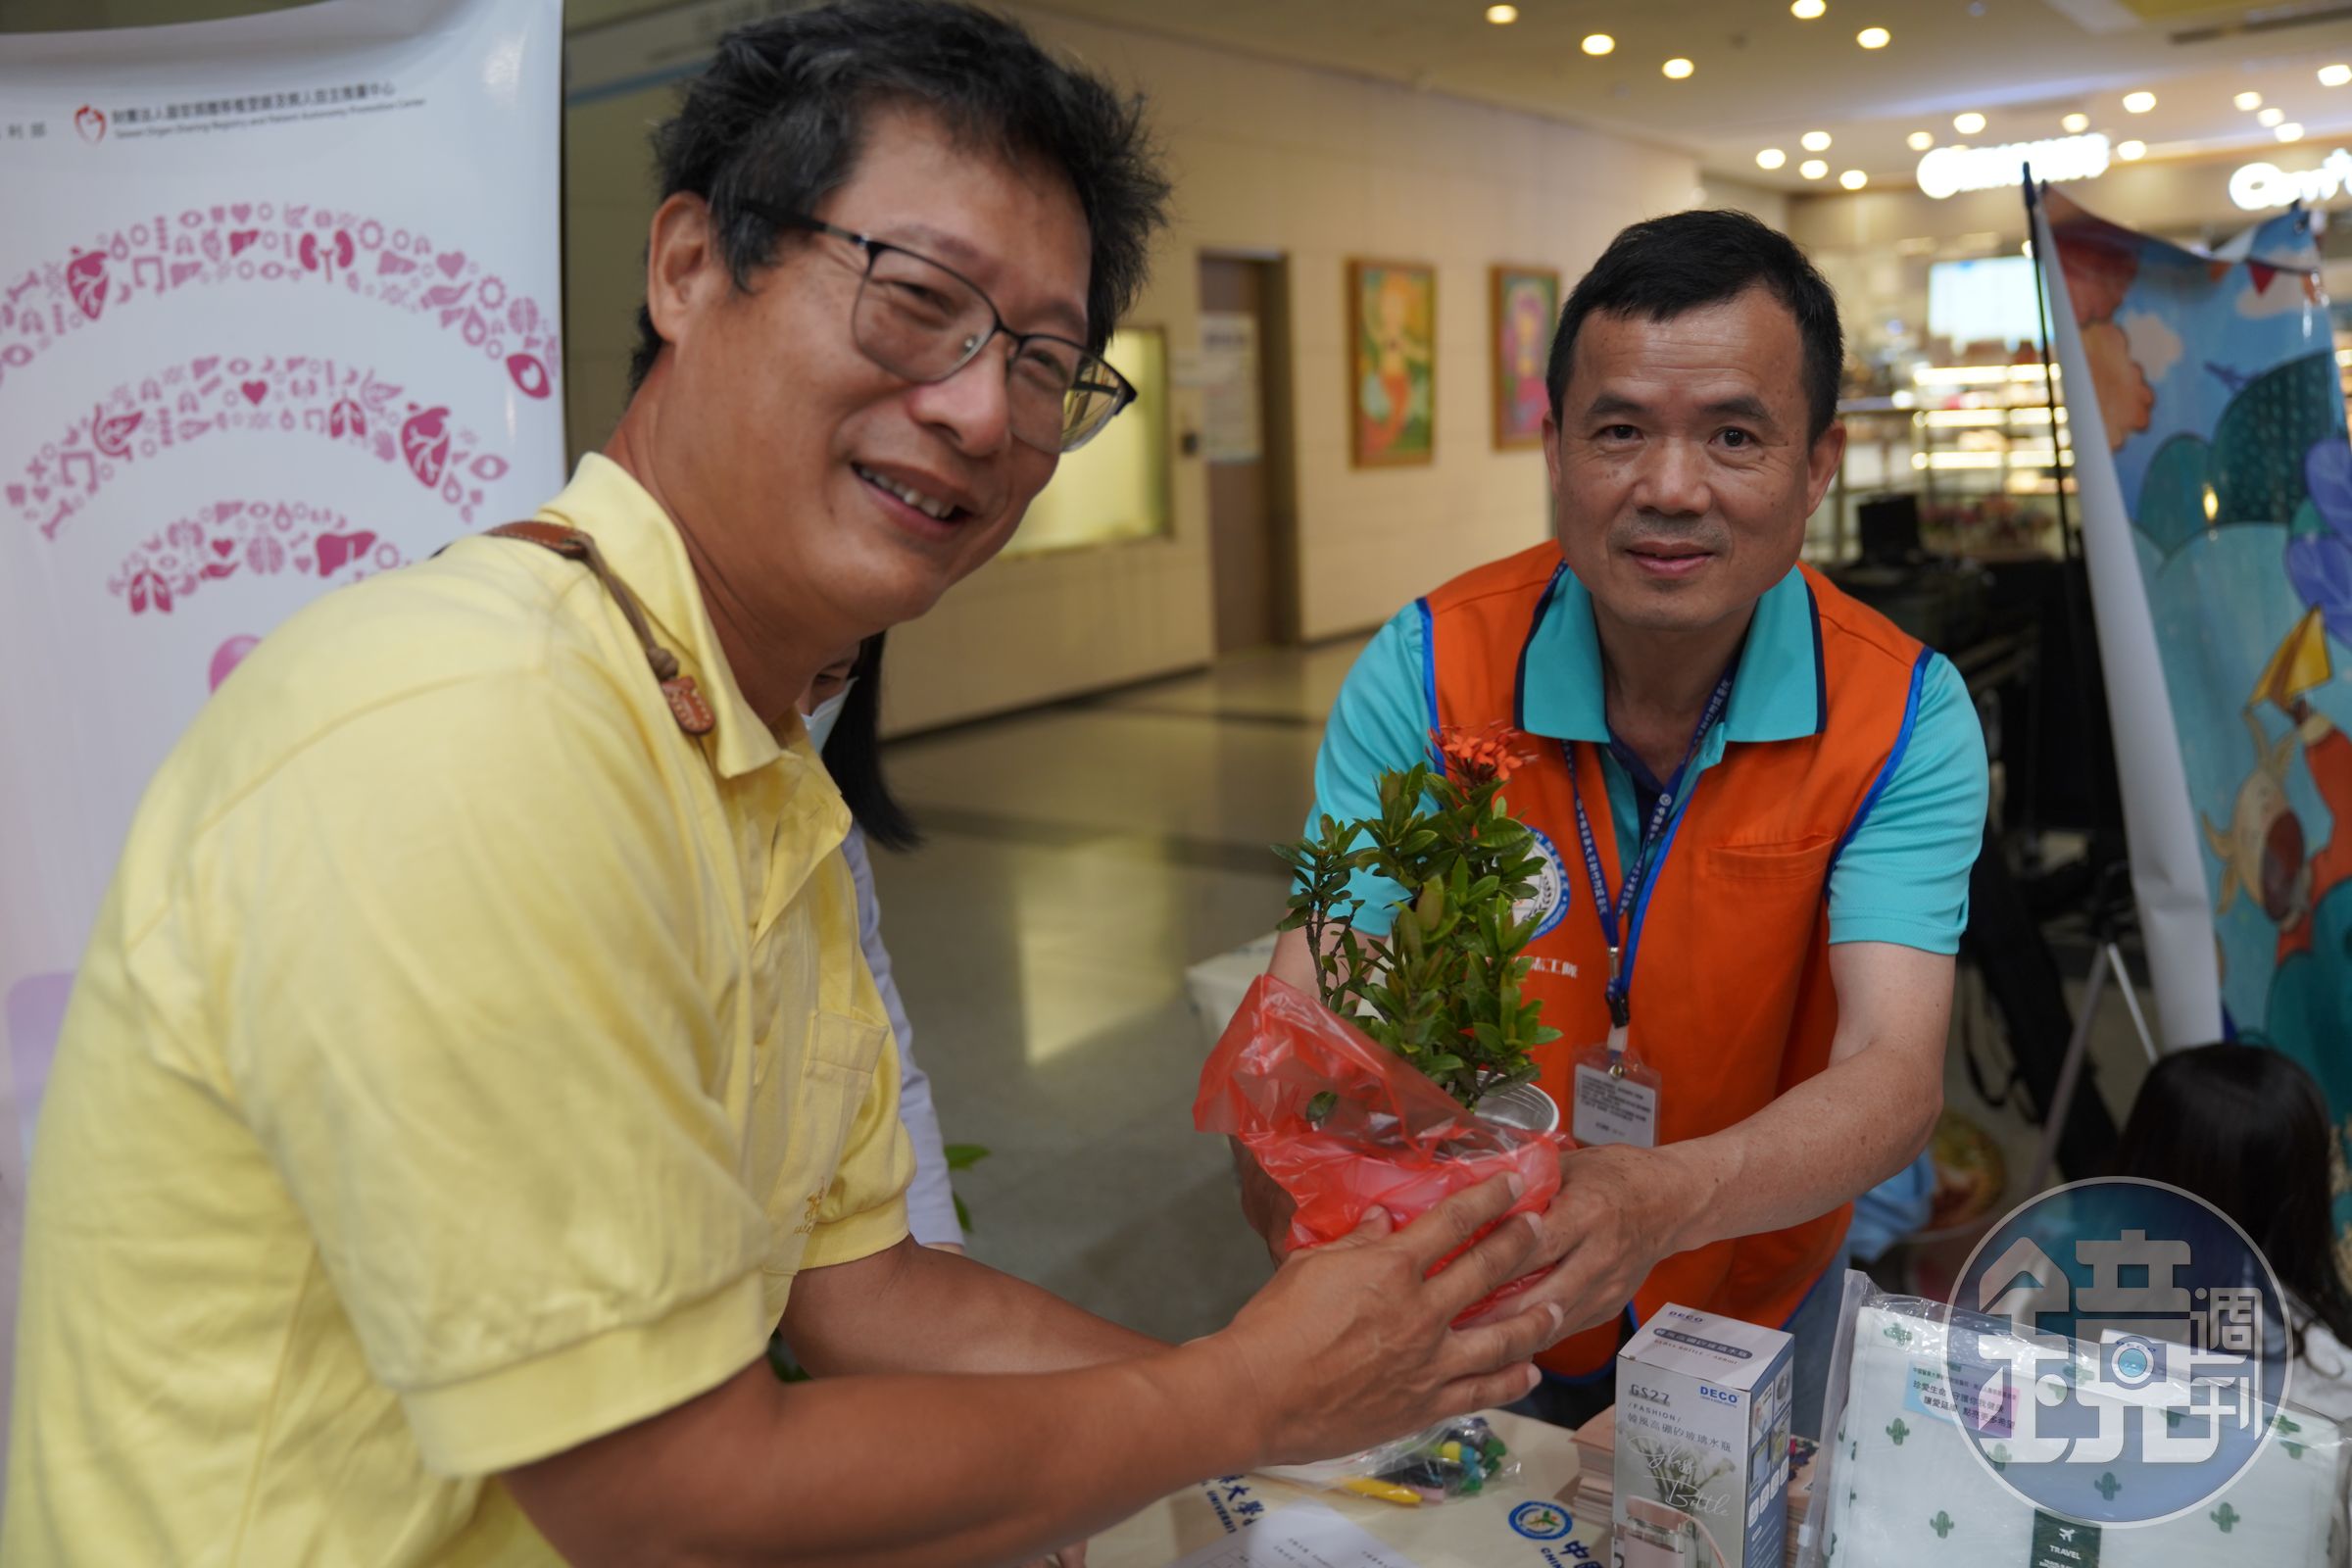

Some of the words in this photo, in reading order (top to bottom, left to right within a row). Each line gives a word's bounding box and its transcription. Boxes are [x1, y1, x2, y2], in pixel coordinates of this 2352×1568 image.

[1668, 1310, 1703, 1323] DECO
[1630, 1383, 1670, 1405] GS27
[1699, 1386, 1739, 1403] DECO
[1913, 1380, 1946, 1397] 珍愛生命
[2049, 1544, 2082, 1560] TRAVEL
